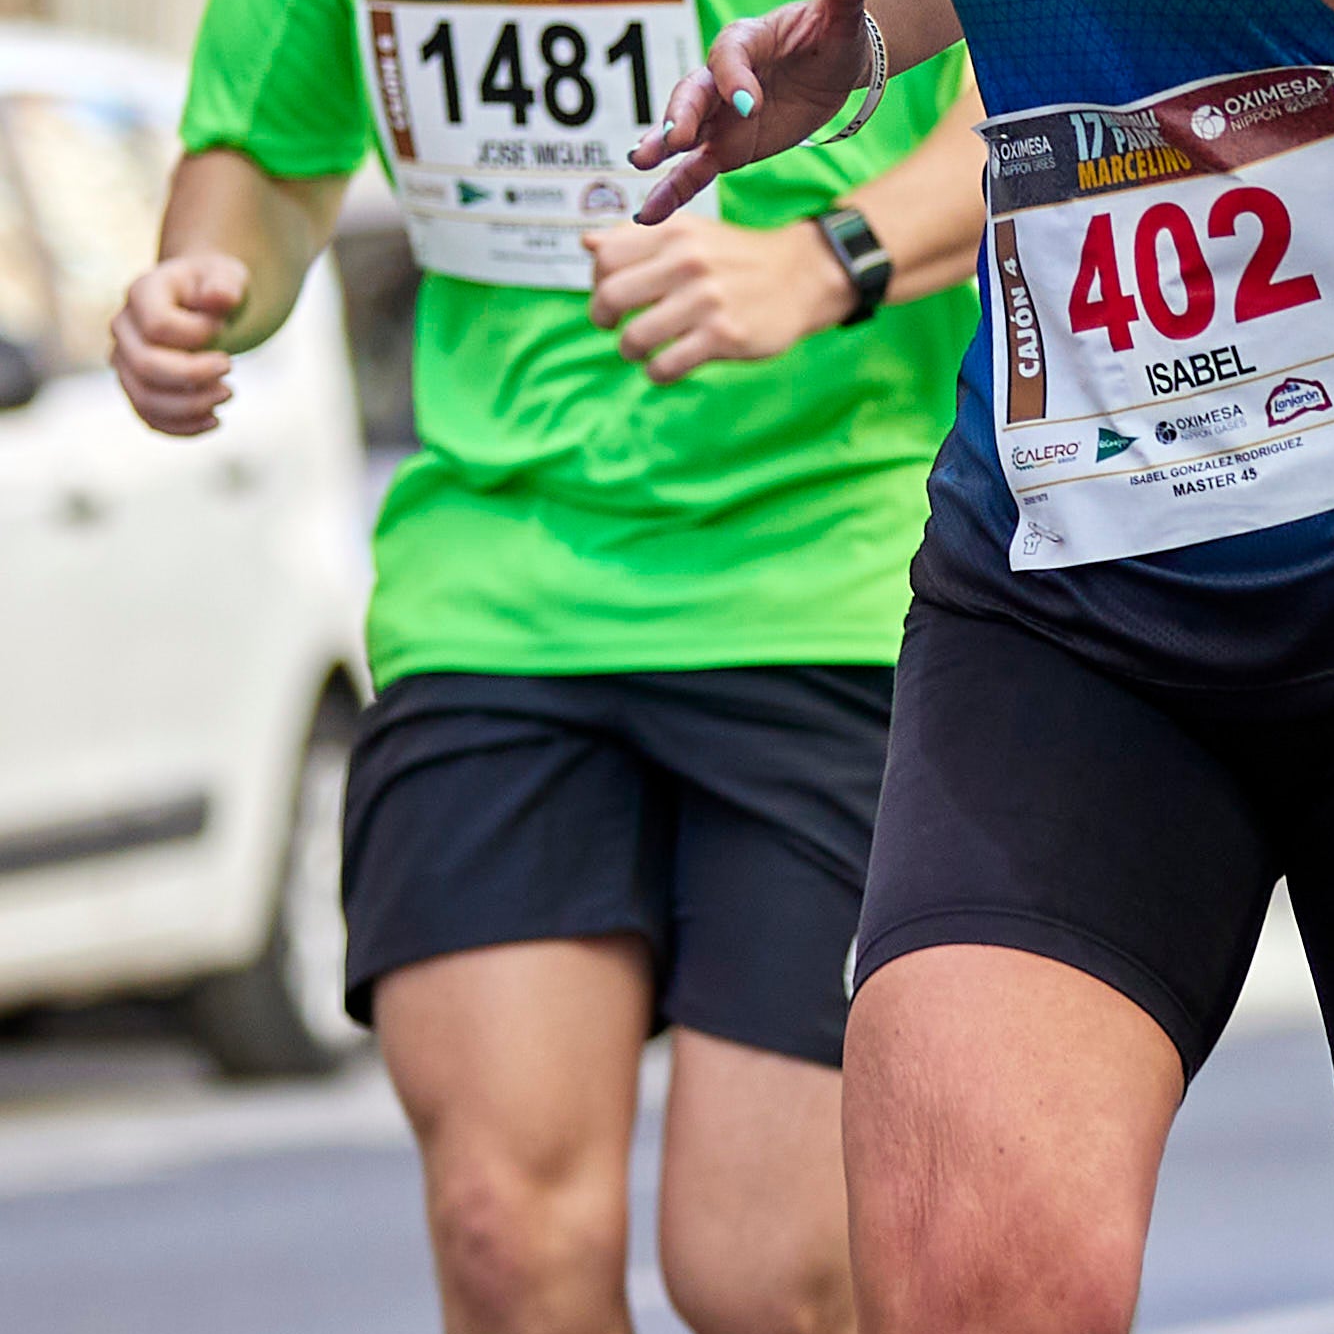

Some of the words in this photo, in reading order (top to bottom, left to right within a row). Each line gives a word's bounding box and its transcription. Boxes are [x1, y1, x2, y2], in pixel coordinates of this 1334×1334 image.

[419, 20, 655, 126] 1481
[1225, 77, 1322, 115] OXIMESA
[1070, 112, 1104, 161] 17
[1230, 105, 1282, 132] NIPPON
[1001, 135, 1053, 161] OXIMESA
[1077, 147, 1192, 191] MARCELINO
[1003, 257, 1017, 277] 4
[1068, 187, 1322, 353] 402
[1011, 286, 1040, 379] CAJÓN
[1146, 344, 1257, 397] ISABEL
[1176, 404, 1244, 431] OXIMESA
[1015, 443, 1079, 465] CALERO
[1130, 469, 1167, 486] ISABEL
[1170, 454, 1233, 479] GONZALEZ
[1234, 437, 1304, 466] RODRIGUEZ
[1172, 475, 1237, 498] MASTER
[1240, 467, 1258, 482] 45
